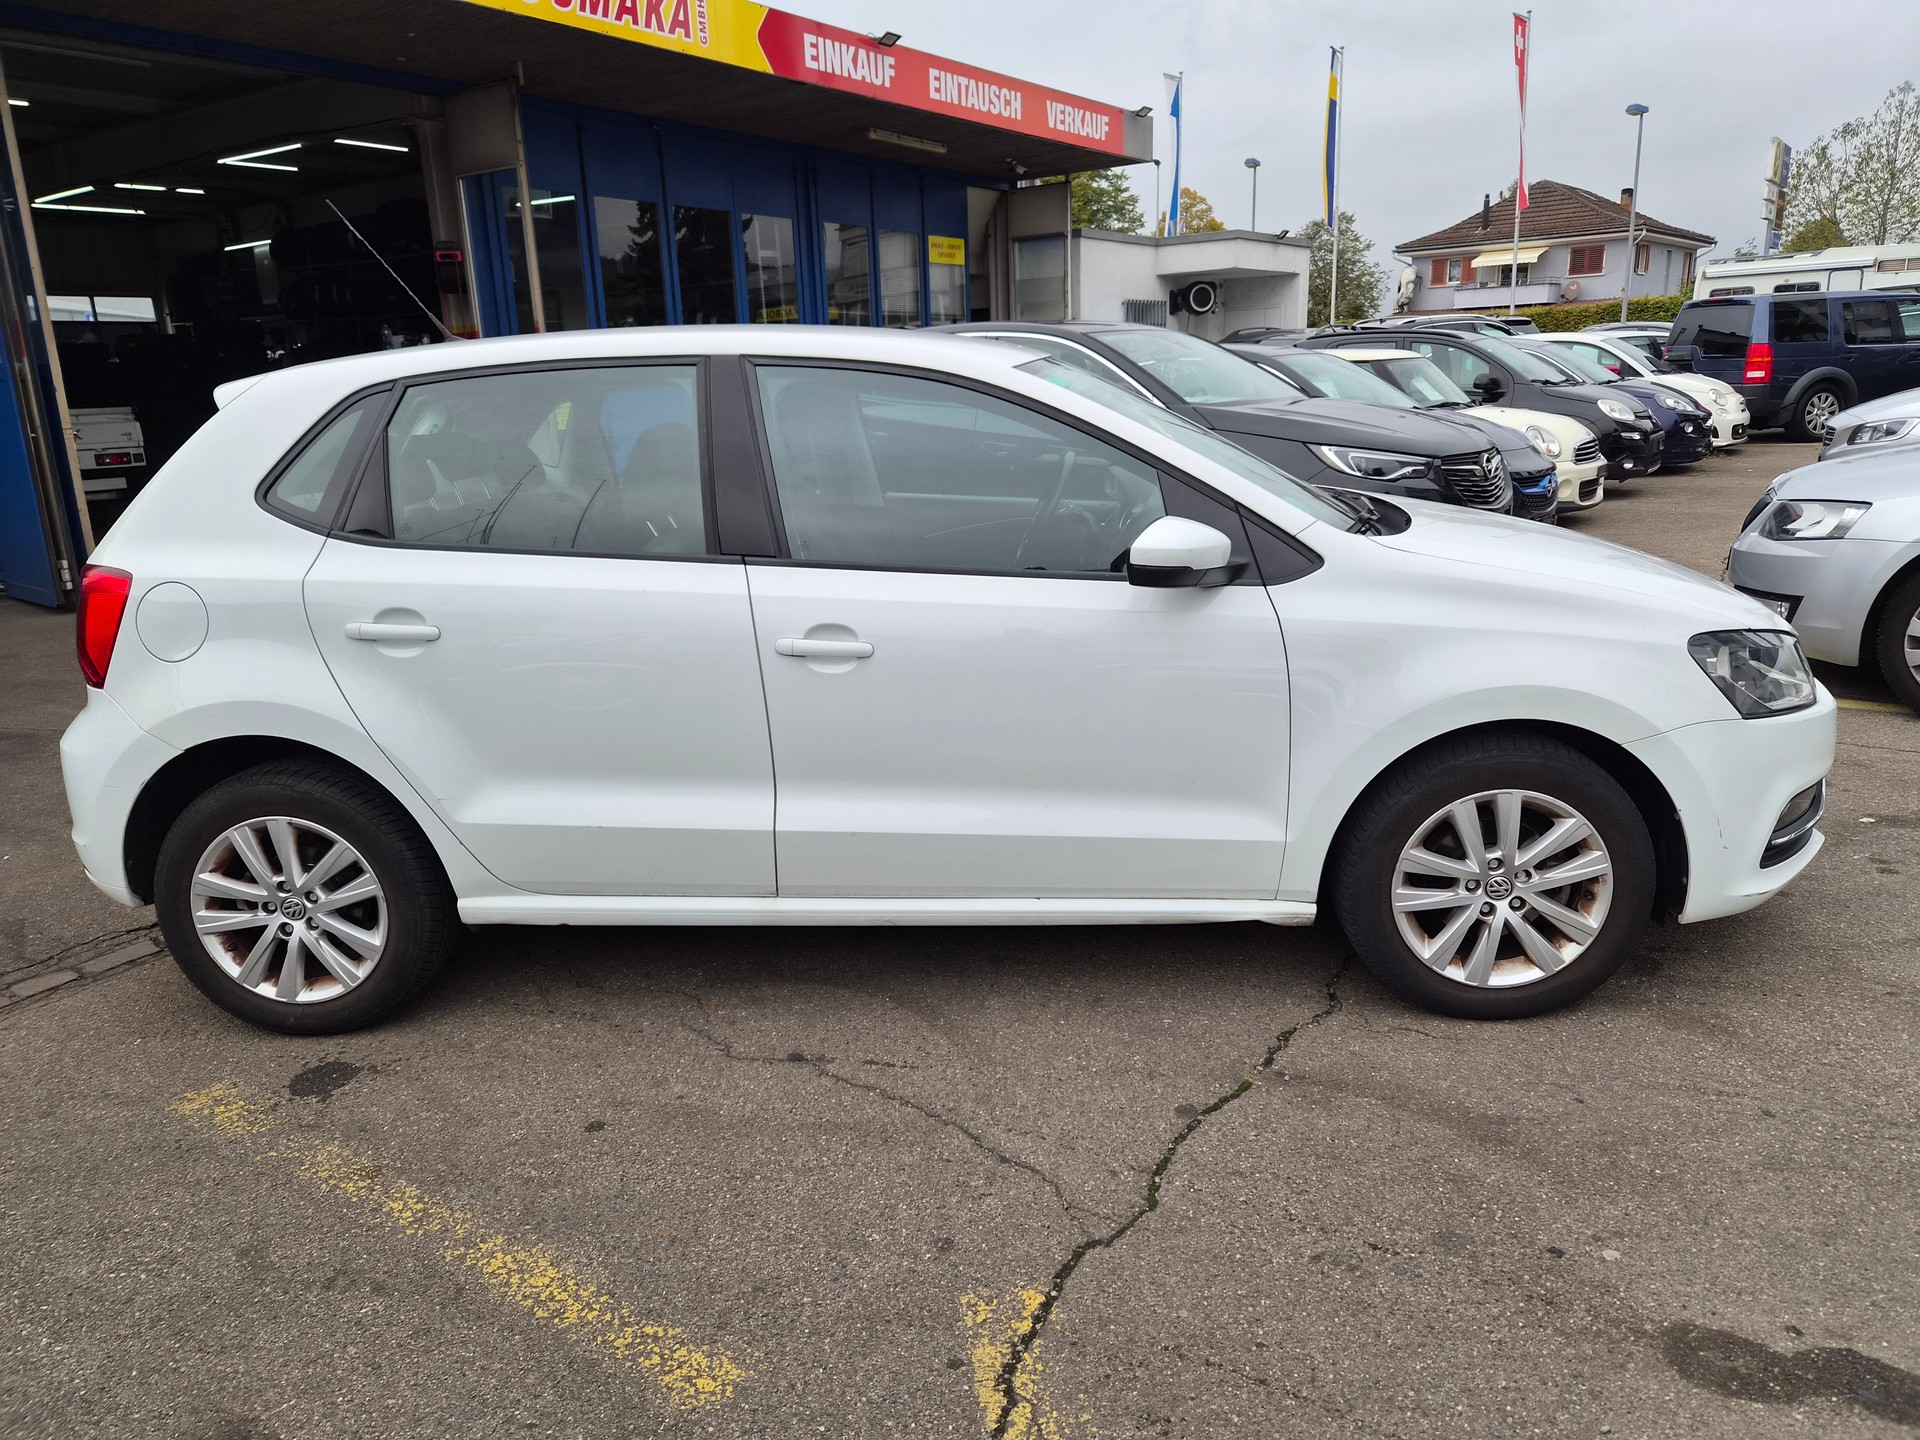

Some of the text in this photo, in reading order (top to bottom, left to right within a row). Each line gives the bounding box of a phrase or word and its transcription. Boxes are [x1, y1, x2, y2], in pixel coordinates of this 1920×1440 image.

[803, 32, 1110, 141] EINKAUF EINTAUSCH VERKAUF
